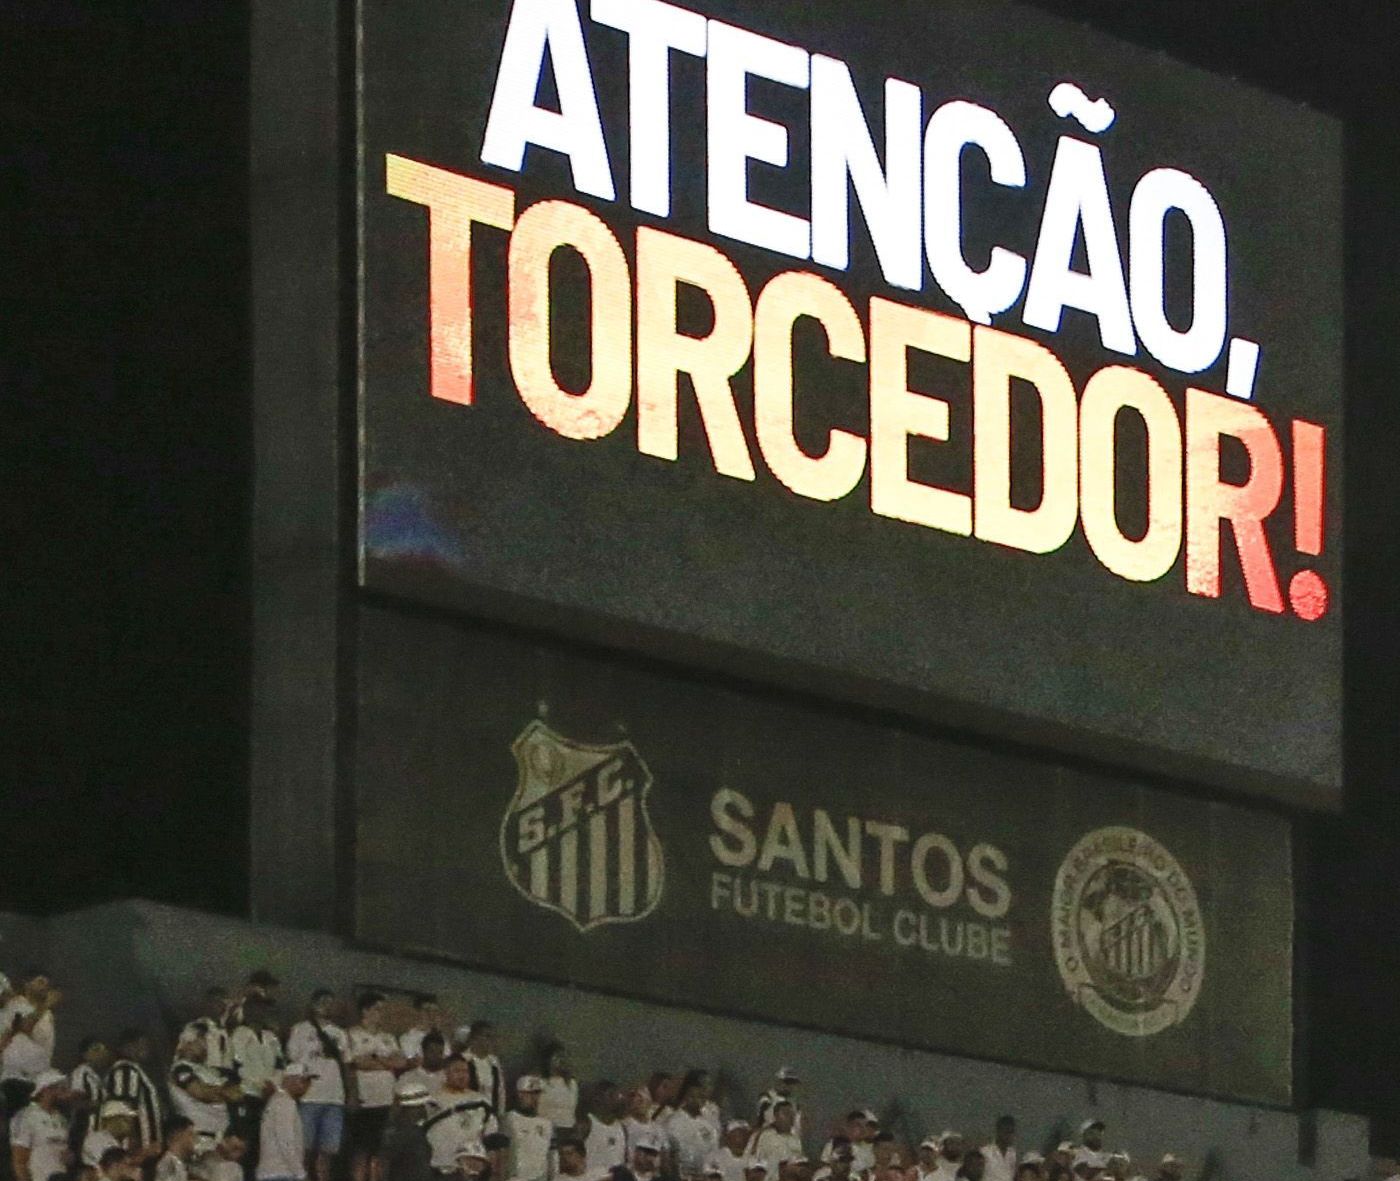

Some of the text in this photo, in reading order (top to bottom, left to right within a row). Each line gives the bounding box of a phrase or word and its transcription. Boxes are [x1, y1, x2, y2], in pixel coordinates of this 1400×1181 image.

[480, 0, 1260, 400] ATENÇÃO,
[385, 153, 1329, 621] TORCEDOR!
[708, 786, 1013, 919] SANTOS
[710, 872, 1013, 967] FUTEBOL CLUBE
